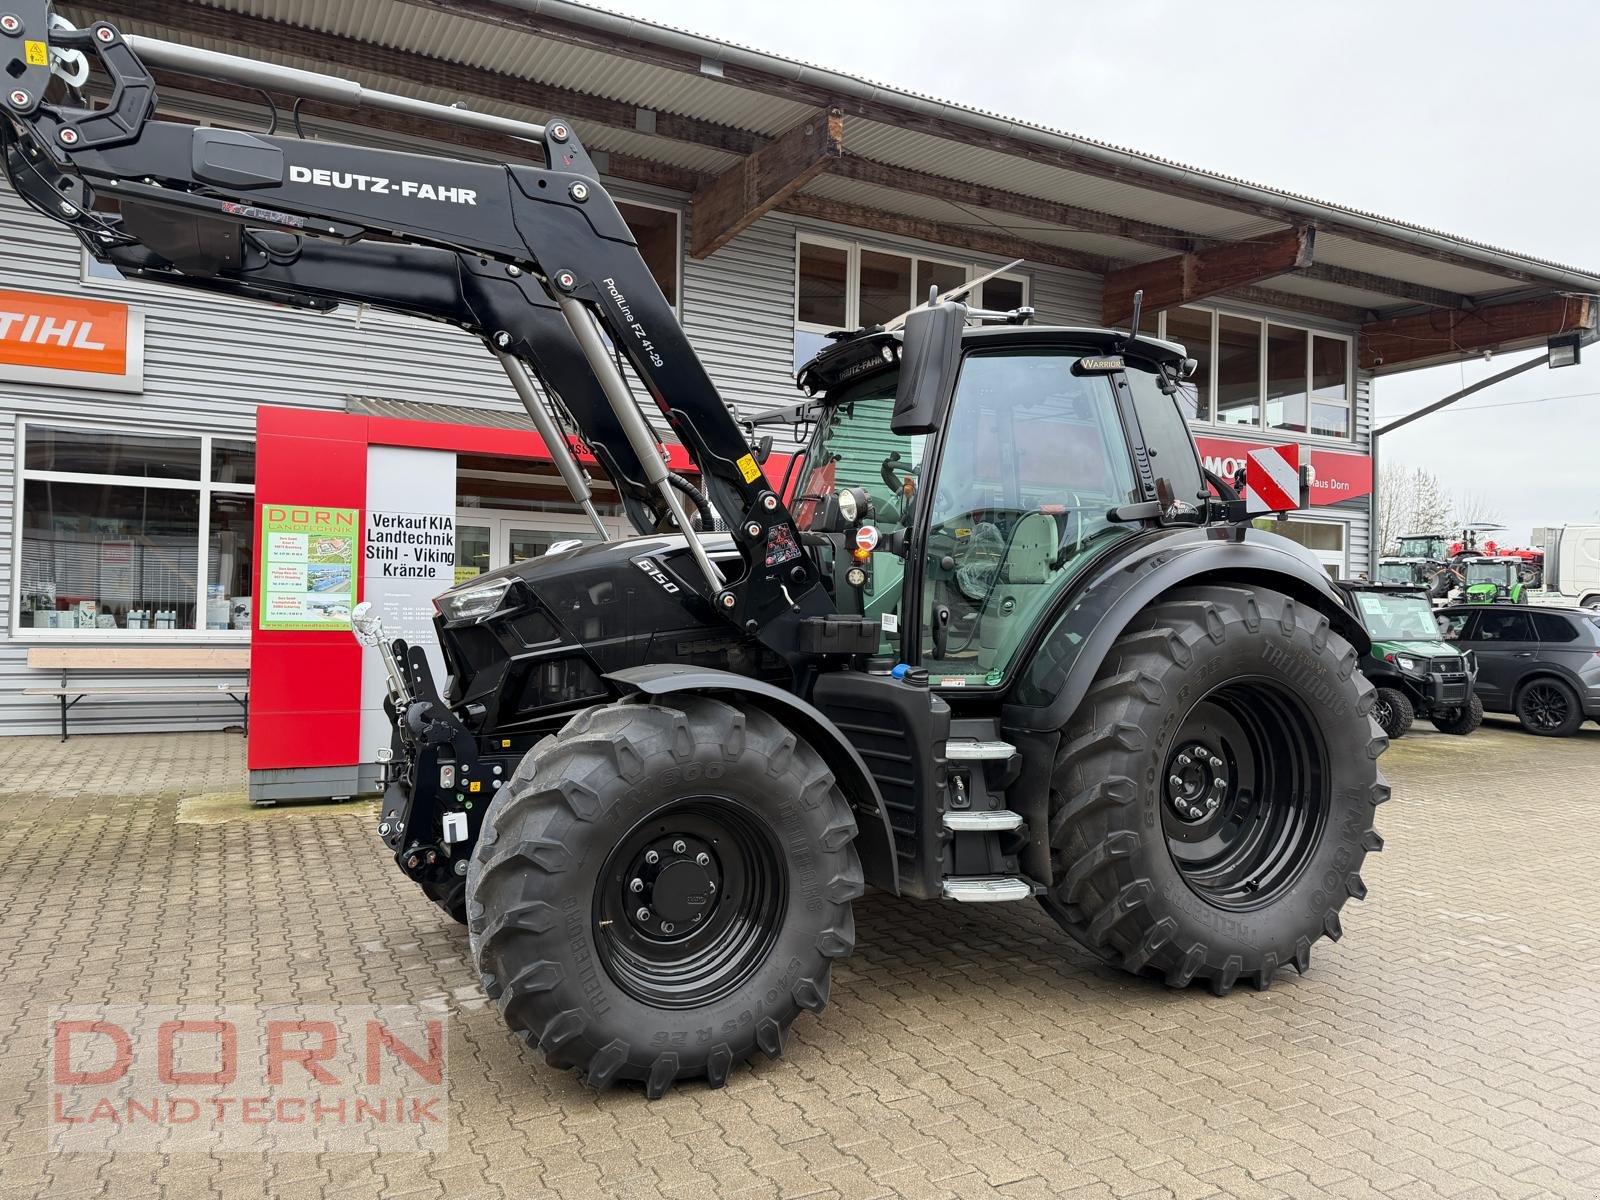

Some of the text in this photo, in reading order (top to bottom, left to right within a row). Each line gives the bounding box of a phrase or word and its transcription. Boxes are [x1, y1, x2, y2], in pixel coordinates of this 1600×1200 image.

[289, 165, 477, 206] DEUTZ-FAHR
[0, 311, 106, 351] TIHL
[603, 277, 664, 367] ProfiLine FZ 41-29
[1330, 478, 1350, 491] Dorn
[268, 508, 353, 526] DORN
[372, 513, 453, 531] Verkauf KIA
[268, 523, 353, 534] LANDTECHNIK
[367, 528, 454, 546] Landtechnik
[366, 545, 398, 560] Stihl
[414, 547, 455, 566] Viking
[383, 562, 436, 578] Kränzle
[636, 560, 680, 593] 6150
